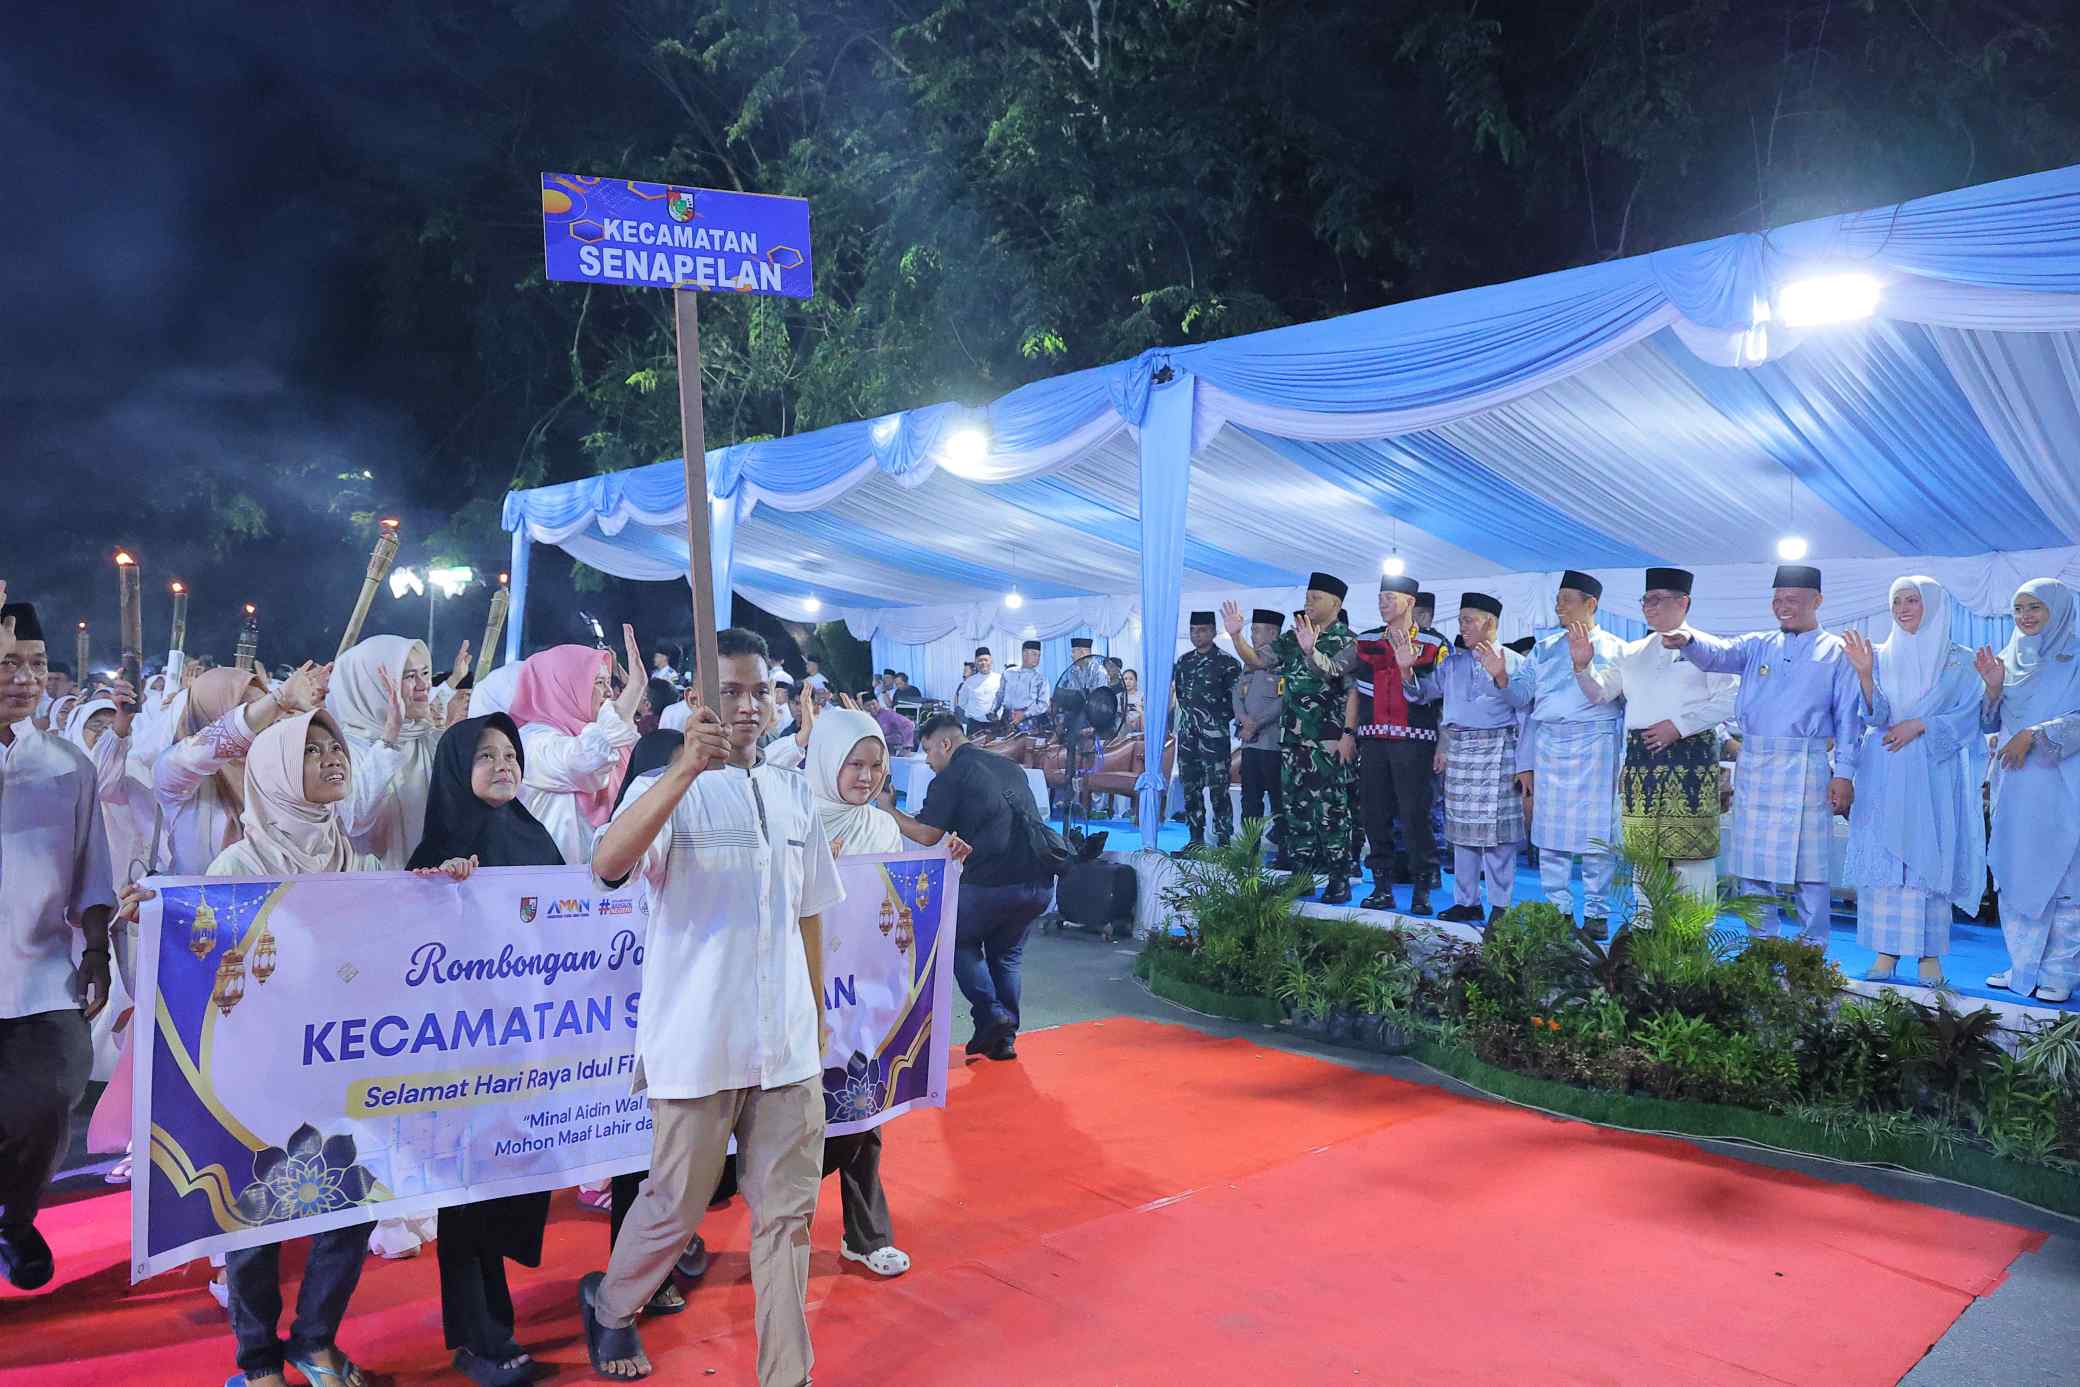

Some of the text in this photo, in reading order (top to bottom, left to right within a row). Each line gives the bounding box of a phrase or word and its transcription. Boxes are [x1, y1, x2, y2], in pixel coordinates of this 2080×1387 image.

[603, 217, 757, 254] KECAMATAN
[579, 244, 782, 292] SENAPELAN
[547, 899, 590, 914] AMAN
[405, 942, 602, 986] Rombongan
[303, 995, 612, 1066] KECAMATAN
[364, 1054, 635, 1109] Selamat Hari Raya Idul Fi
[575, 1101, 611, 1121] Aidin
[615, 1096, 643, 1113] Wal
[495, 1116, 653, 1157] Mohon Maaf Lahir da
